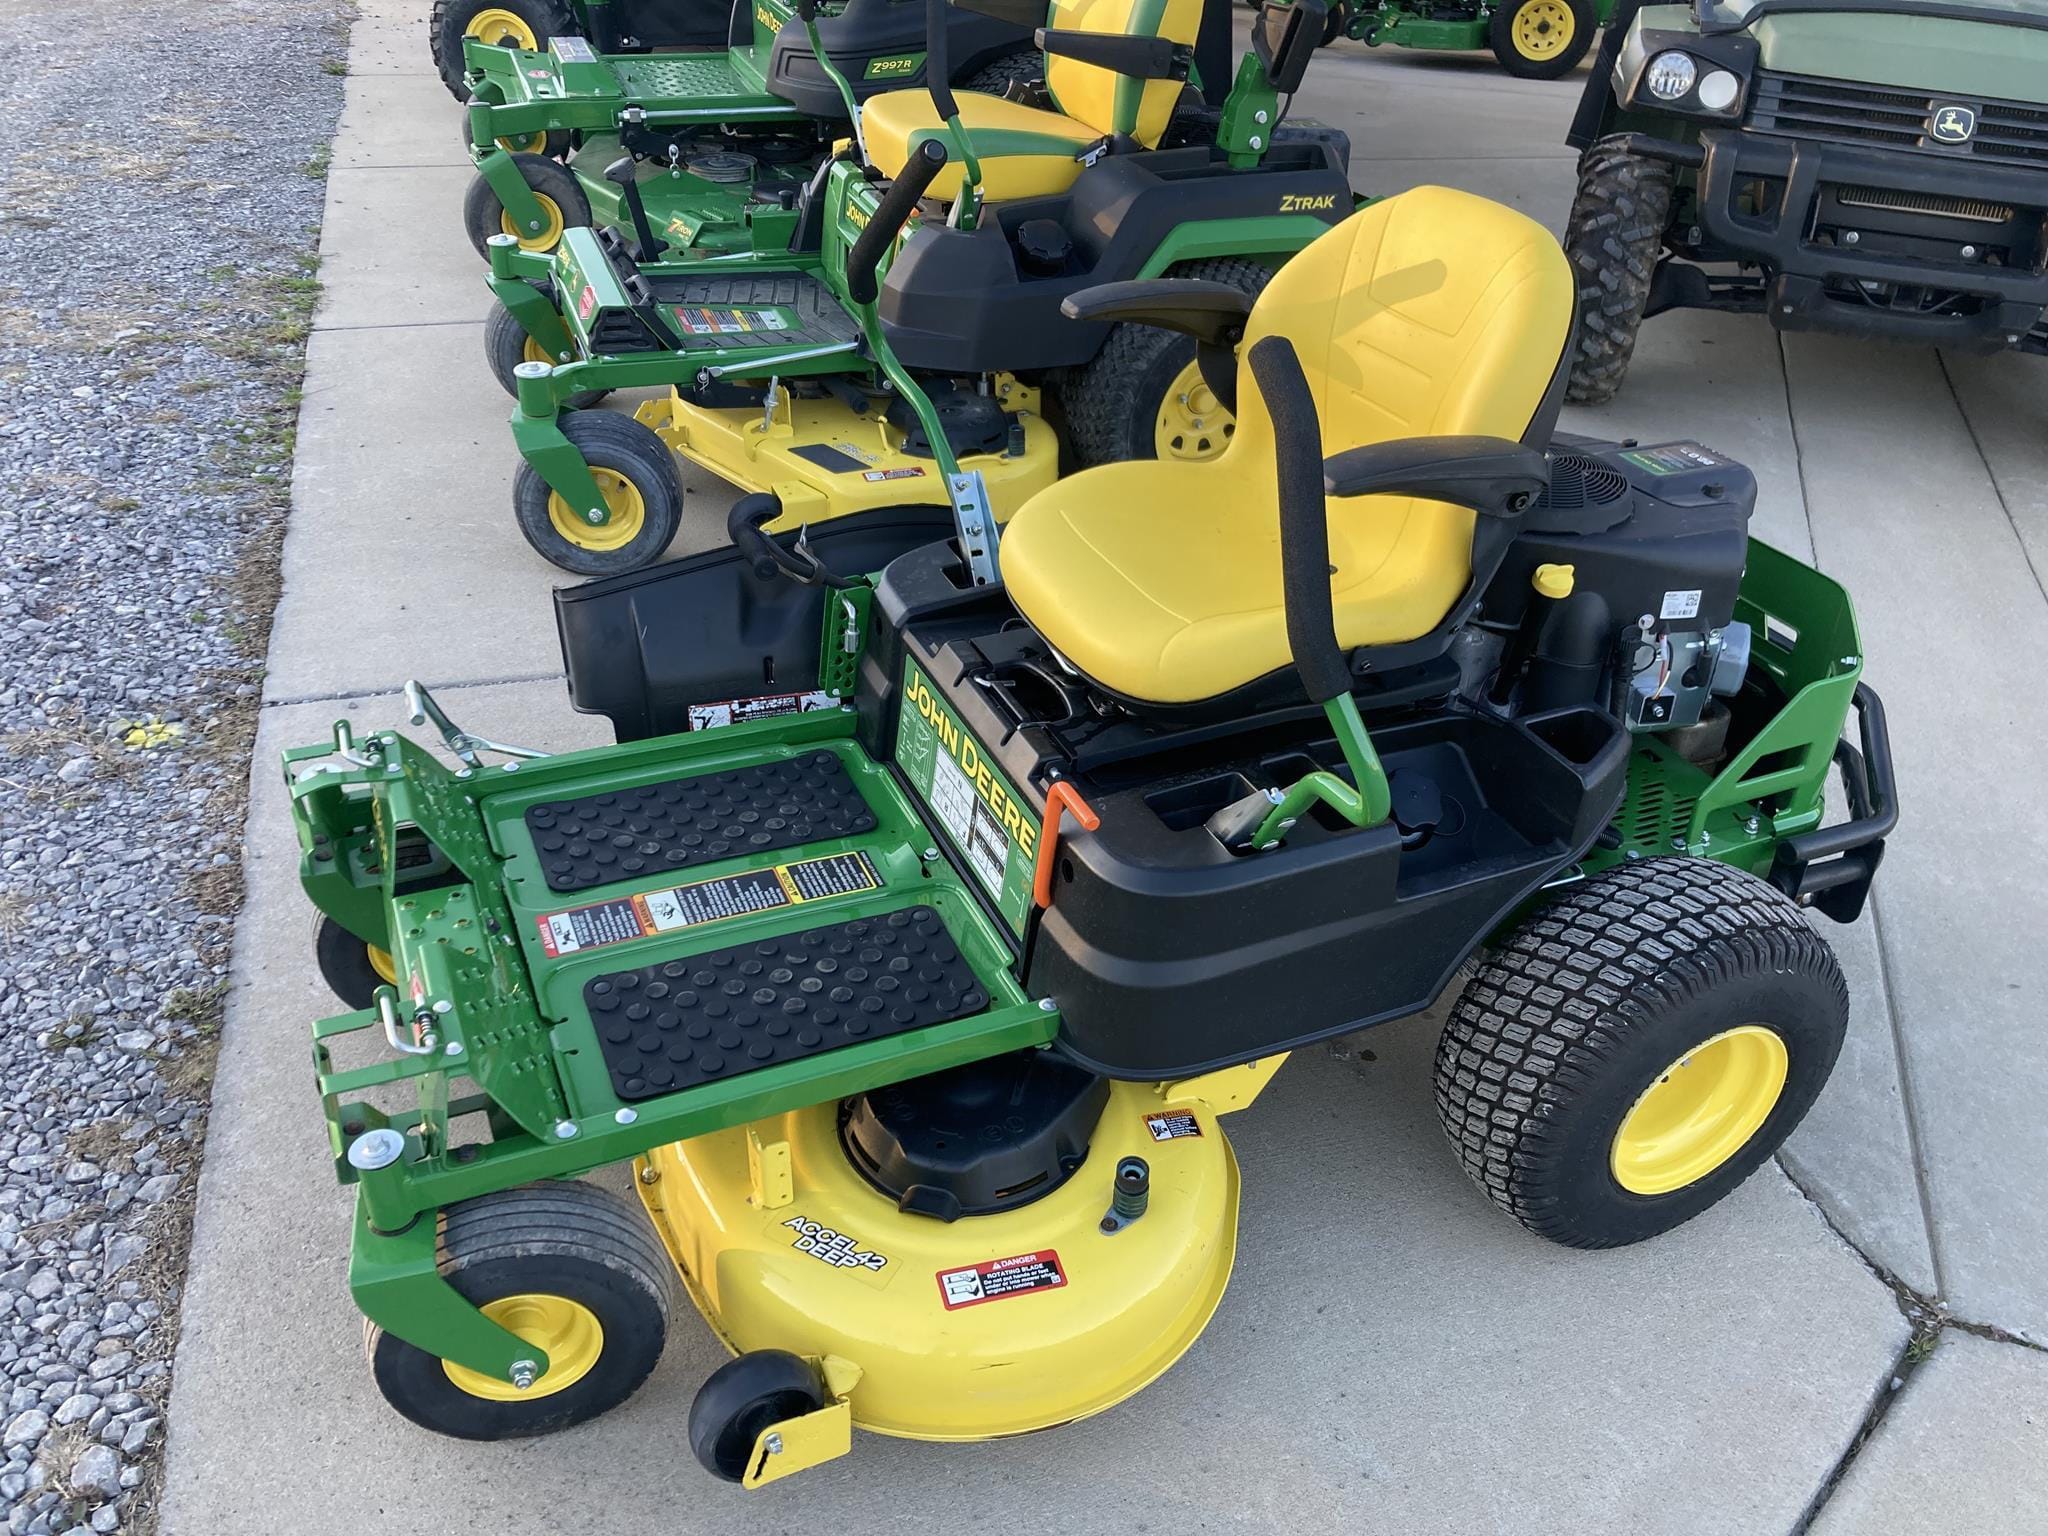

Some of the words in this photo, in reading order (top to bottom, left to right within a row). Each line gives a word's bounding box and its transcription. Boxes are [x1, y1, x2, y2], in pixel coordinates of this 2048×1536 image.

[872, 60, 912, 73] Z997R
[1280, 195, 1336, 211] ZTRAK
[906, 671, 959, 757] JOHN
[961, 735, 1036, 860] DEERE
[1155, 1109, 1192, 1119] WARNING
[782, 1216, 859, 1256] ACCEL
[853, 1251, 888, 1272] 42
[791, 1234, 859, 1268] DEEP
[1001, 1254, 1037, 1268] DANGER
[987, 1267, 1020, 1279] ROTATING
[1021, 1263, 1045, 1273] BLADE
